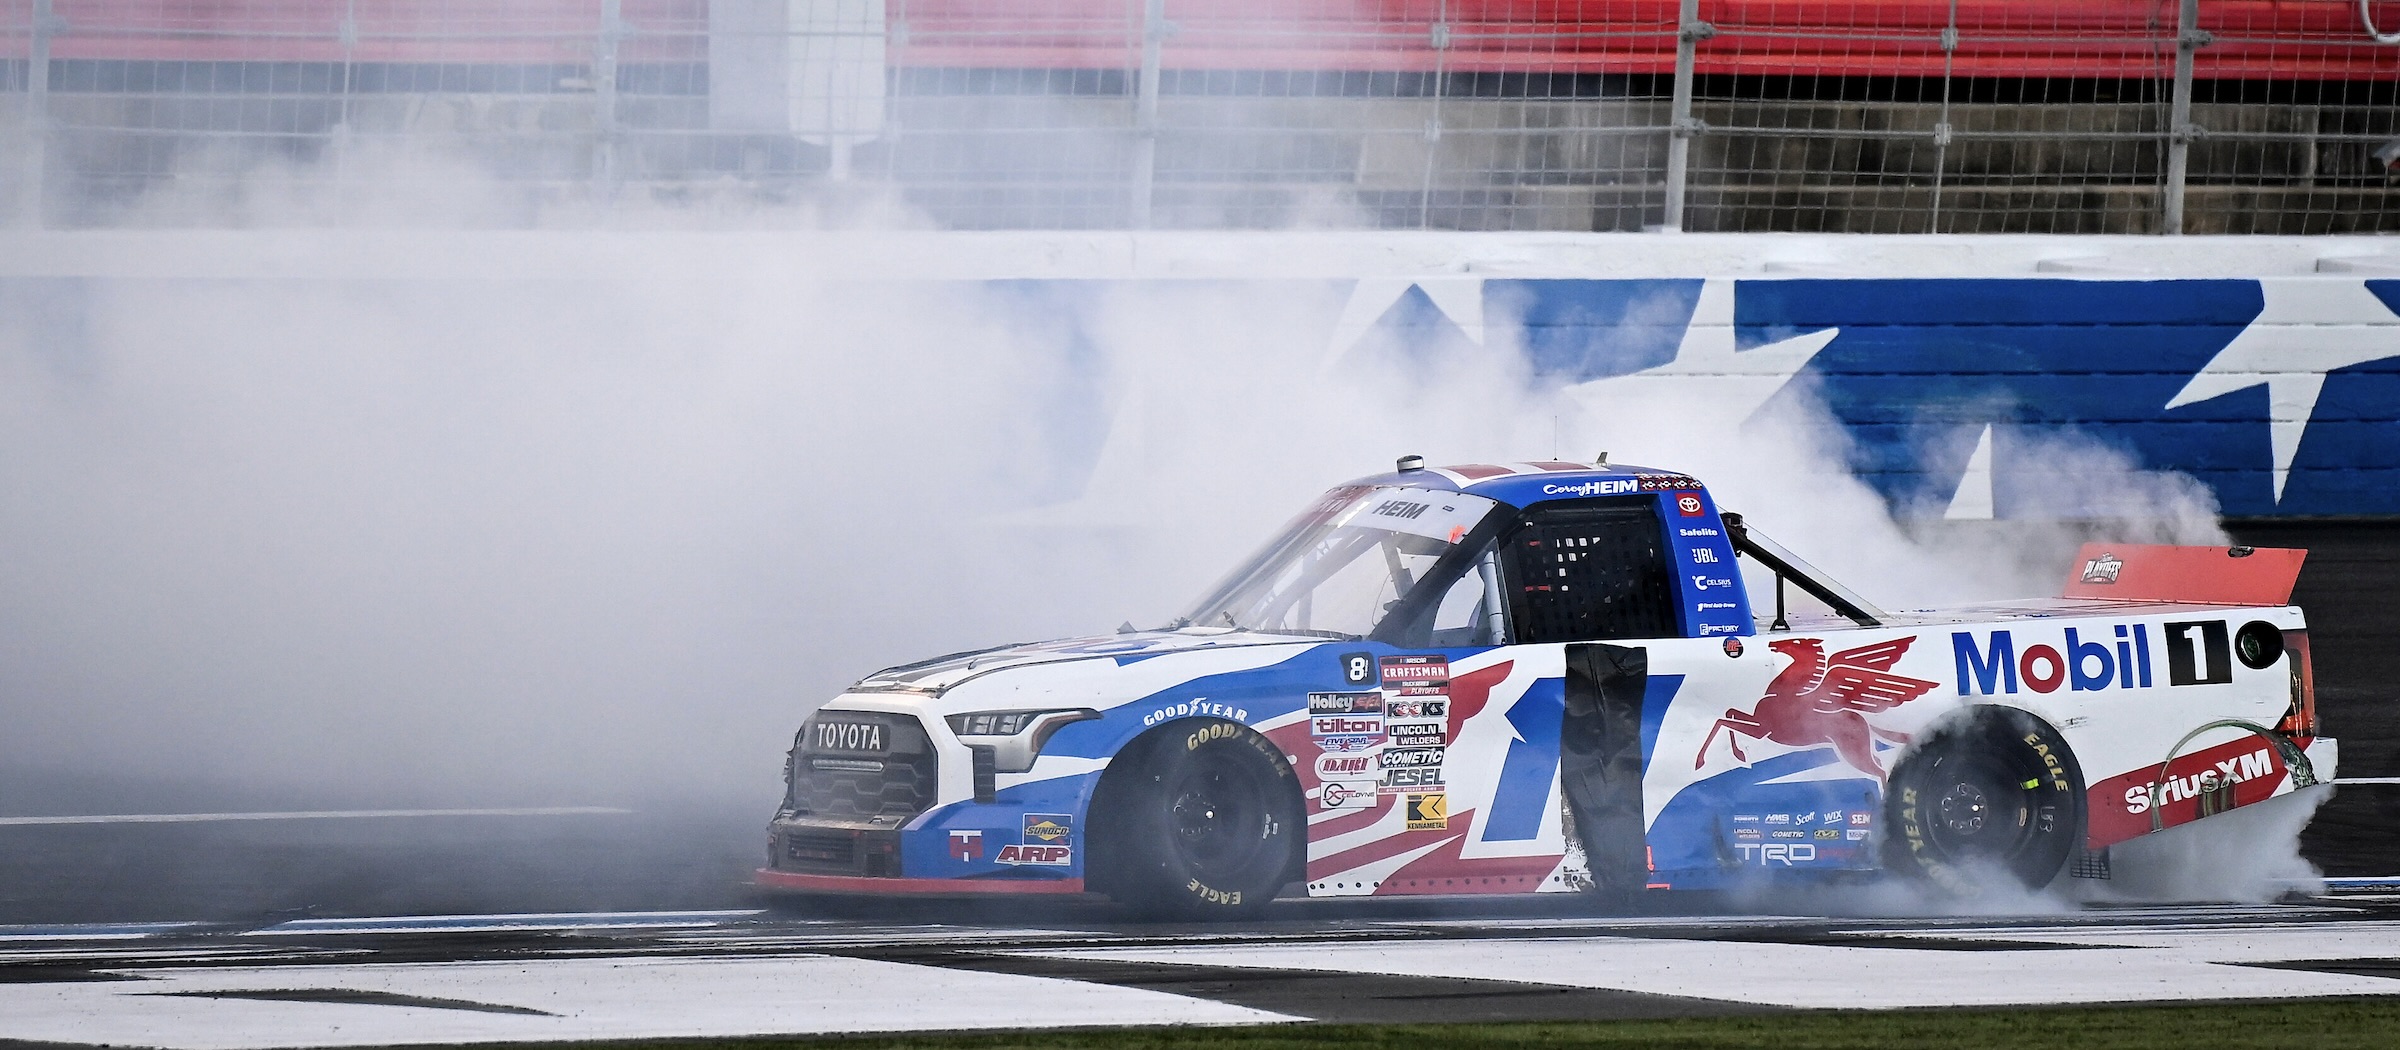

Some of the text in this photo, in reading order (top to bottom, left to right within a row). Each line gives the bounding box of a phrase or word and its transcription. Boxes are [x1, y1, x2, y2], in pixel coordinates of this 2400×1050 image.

[1585, 479, 1638, 495] HEIM
[1372, 500, 1431, 520] HEIM
[1679, 528, 1718, 537] Safelite
[1692, 548, 1719, 564] JBL
[2081, 560, 2123, 582] PLAYOFFS
[1951, 623, 2208, 696] Mobil 1
[1349, 657, 1366, 681] 8
[1383, 666, 1445, 678] CRAFTSMAN
[1309, 694, 1354, 712] Holley
[1386, 702, 1446, 718] KOOKS
[1316, 718, 1380, 733] tilton
[1390, 724, 1437, 736] LINCOLN
[817, 722, 881, 750] TOYOTA
[1325, 736, 1368, 746] FIVE STAR
[1401, 736, 1441, 745] WELDERS
[1381, 750, 1443, 765] COMETIC
[2023, 732, 2069, 793] EAGLE
[1379, 768, 1446, 786] JESEL
[2124, 748, 2274, 815] SiriusXM
[1823, 810, 1842, 822] WIX
[1027, 826, 1069, 836] SUNOCO
[1407, 822, 1446, 830] KENNAMETAL
[997, 846, 1070, 863] ARP
[1734, 843, 1816, 866] TRD
[1186, 878, 1242, 905] EAGLE
